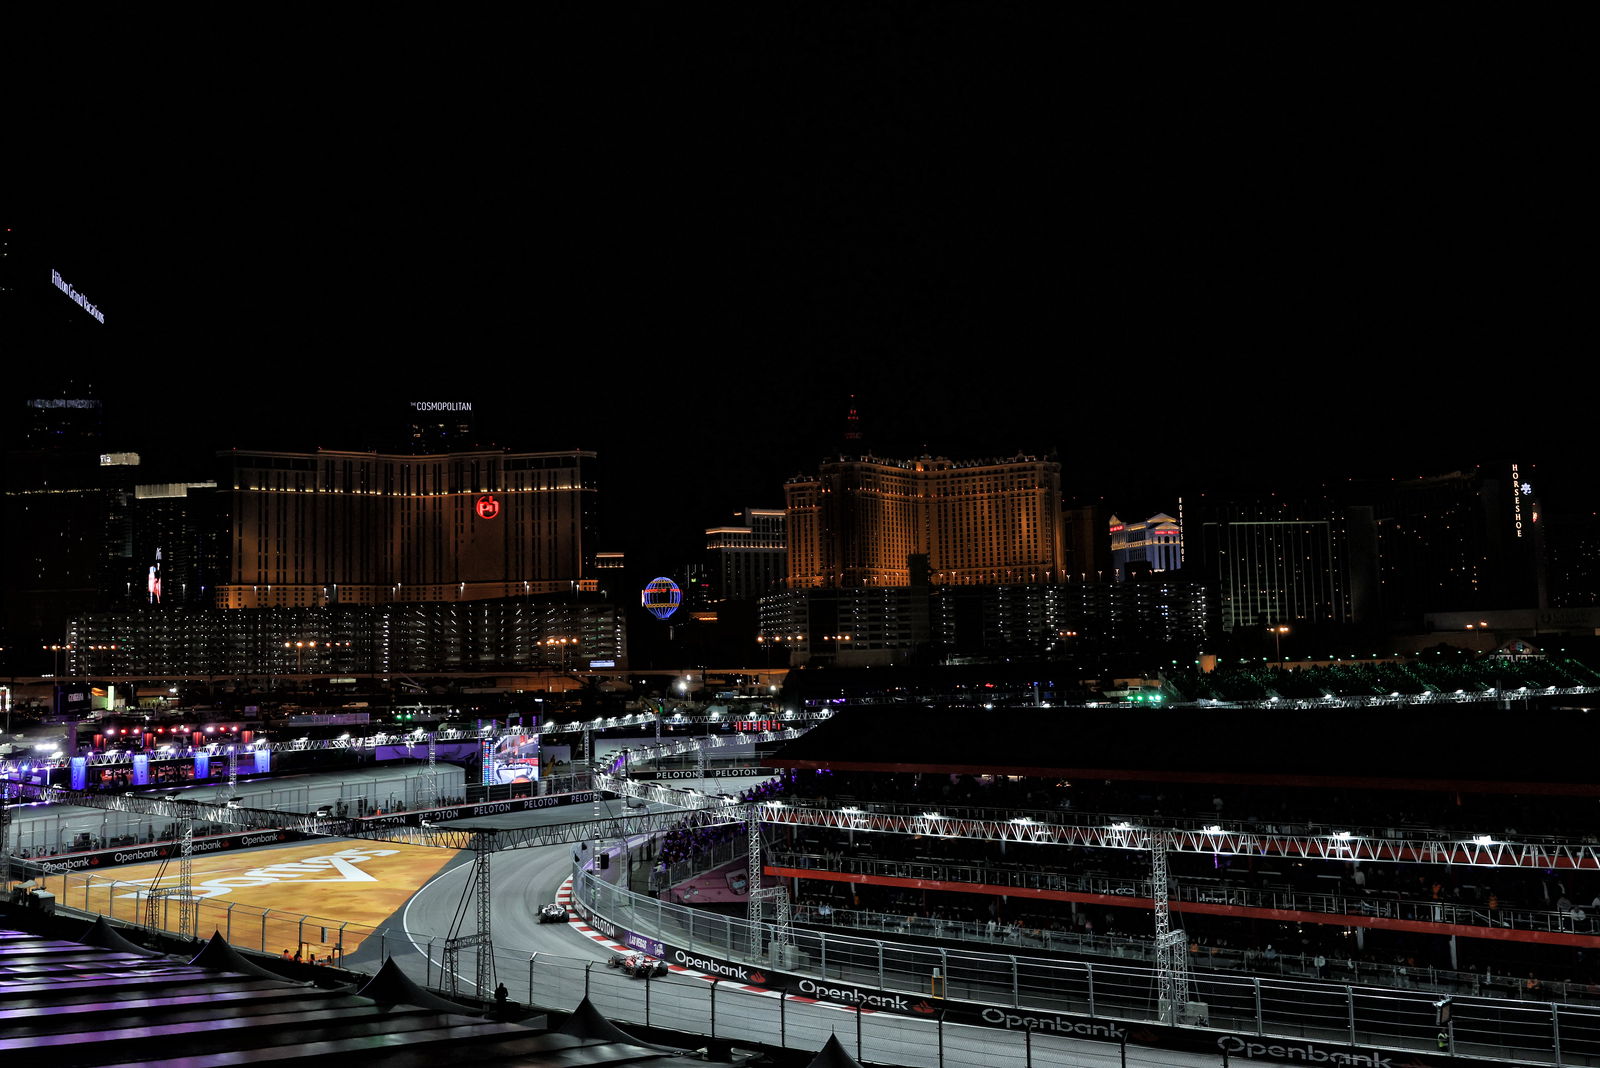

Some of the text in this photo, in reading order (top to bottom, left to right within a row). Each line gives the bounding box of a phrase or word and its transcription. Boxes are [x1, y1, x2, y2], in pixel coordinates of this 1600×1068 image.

[51, 268, 105, 325] Hilton Grand Vacations
[416, 401, 472, 411] COSMOPOLITAN
[1512, 464, 1522, 538] HORSESHOE
[656, 771, 699, 779] PELOTON
[715, 769, 758, 777] PELOTON
[474, 802, 511, 815] PELOTON
[524, 797, 559, 809] PELOTON
[42, 857, 90, 873] Openbank
[114, 848, 158, 863] Openbank
[241, 833, 278, 845] Openbank
[592, 914, 615, 938] PELOTON
[674, 950, 748, 981] Openbank
[798, 979, 909, 1011] Openbank
[981, 1008, 1126, 1038] Openbank
[1216, 1036, 1392, 1068] Openbank
